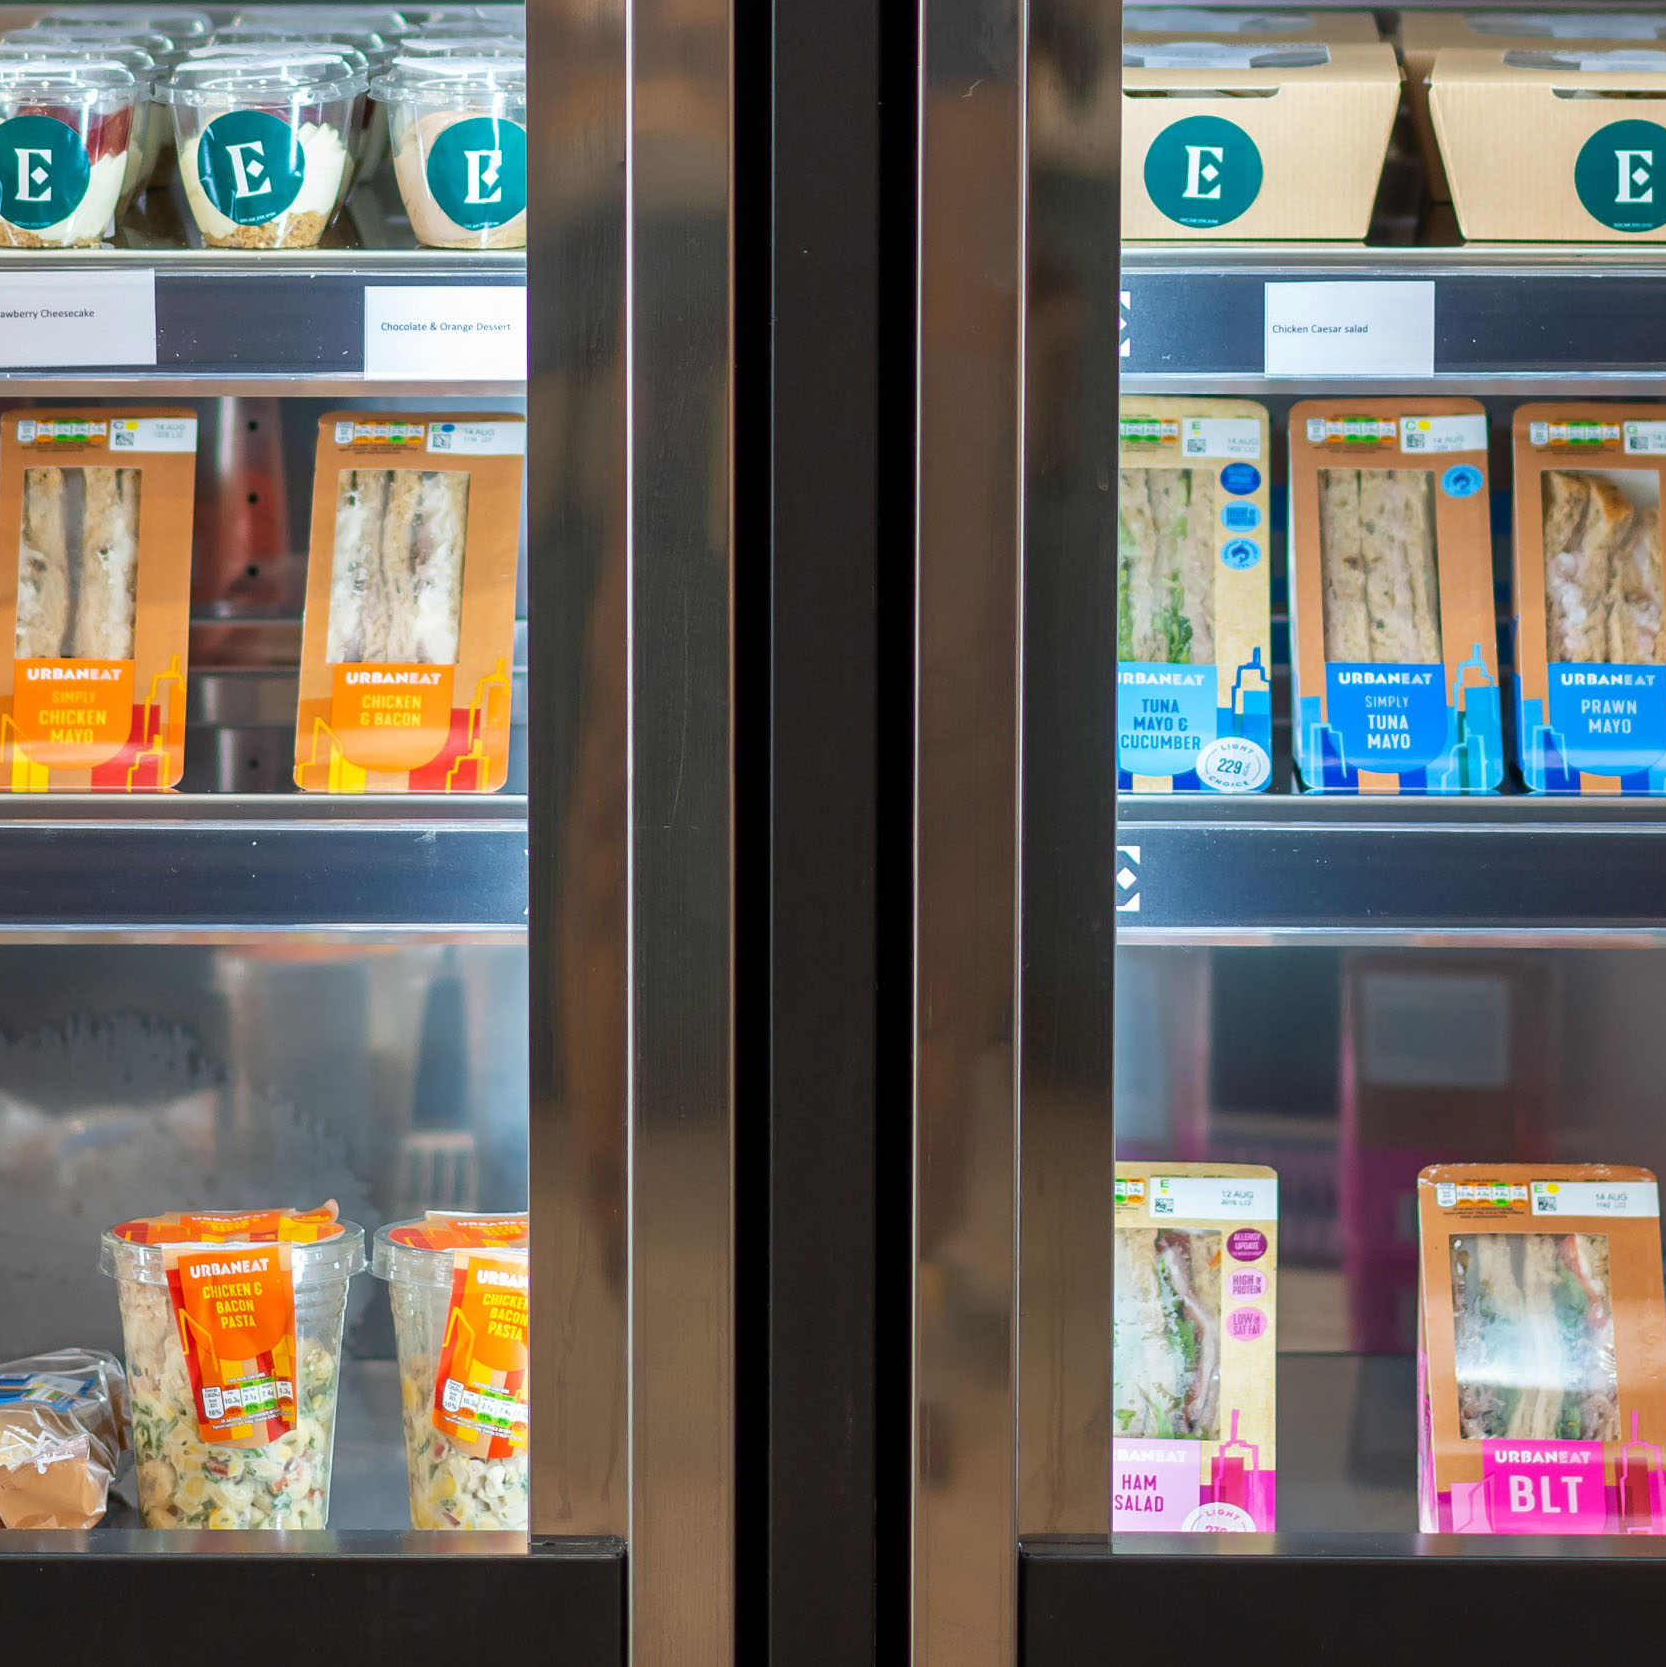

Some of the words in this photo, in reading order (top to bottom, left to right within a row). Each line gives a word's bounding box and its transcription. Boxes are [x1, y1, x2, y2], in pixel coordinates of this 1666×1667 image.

[40, 308, 96, 319] Cheesecake
[380, 321, 428, 331] Chocolate
[429, 321, 438, 331] &
[439, 322, 475, 333] Orange
[476, 322, 511, 331] Dessert
[1272, 324, 1309, 334] Chicken
[1310, 324, 1343, 334] Caesar
[1344, 323, 1369, 334] salad
[27, 668, 121, 681] URBANEAT
[346, 672, 441, 684] URBANEAT
[1339, 673, 1432, 684] URBANEAT
[1561, 673, 1655, 686] URBANEAT
[52, 691, 96, 704] SIMPLY
[362, 695, 421, 709] CHICKEN
[1365, 695, 1408, 707] SIMPLY
[1141, 699, 1179, 713] TUNA
[1581, 699, 1637, 714] PRAWN
[38, 709, 106, 725] CHICKEN
[374, 712, 422, 726] BACON
[1134, 716, 1172, 730] MAYO
[1368, 715, 1408, 729] TUNA
[1588, 719, 1631, 734] MAYO
[49, 728, 93, 745] MAYO
[1121, 735, 1200, 750] CUCUMBER
[1368, 734, 1410, 749] MAYO
[1221, 743, 1253, 754] LIGHT
[1217, 759, 1242, 775] 229
[190, 1259, 269, 1278] URBANEAT
[202, 1283, 252, 1299] CHICKEN
[216, 1300, 254, 1314] BACON
[221, 1314, 256, 1329] PASTA
[1495, 1450, 1590, 1464] URBANEAT
[1510, 1477, 1583, 1513] BLT
